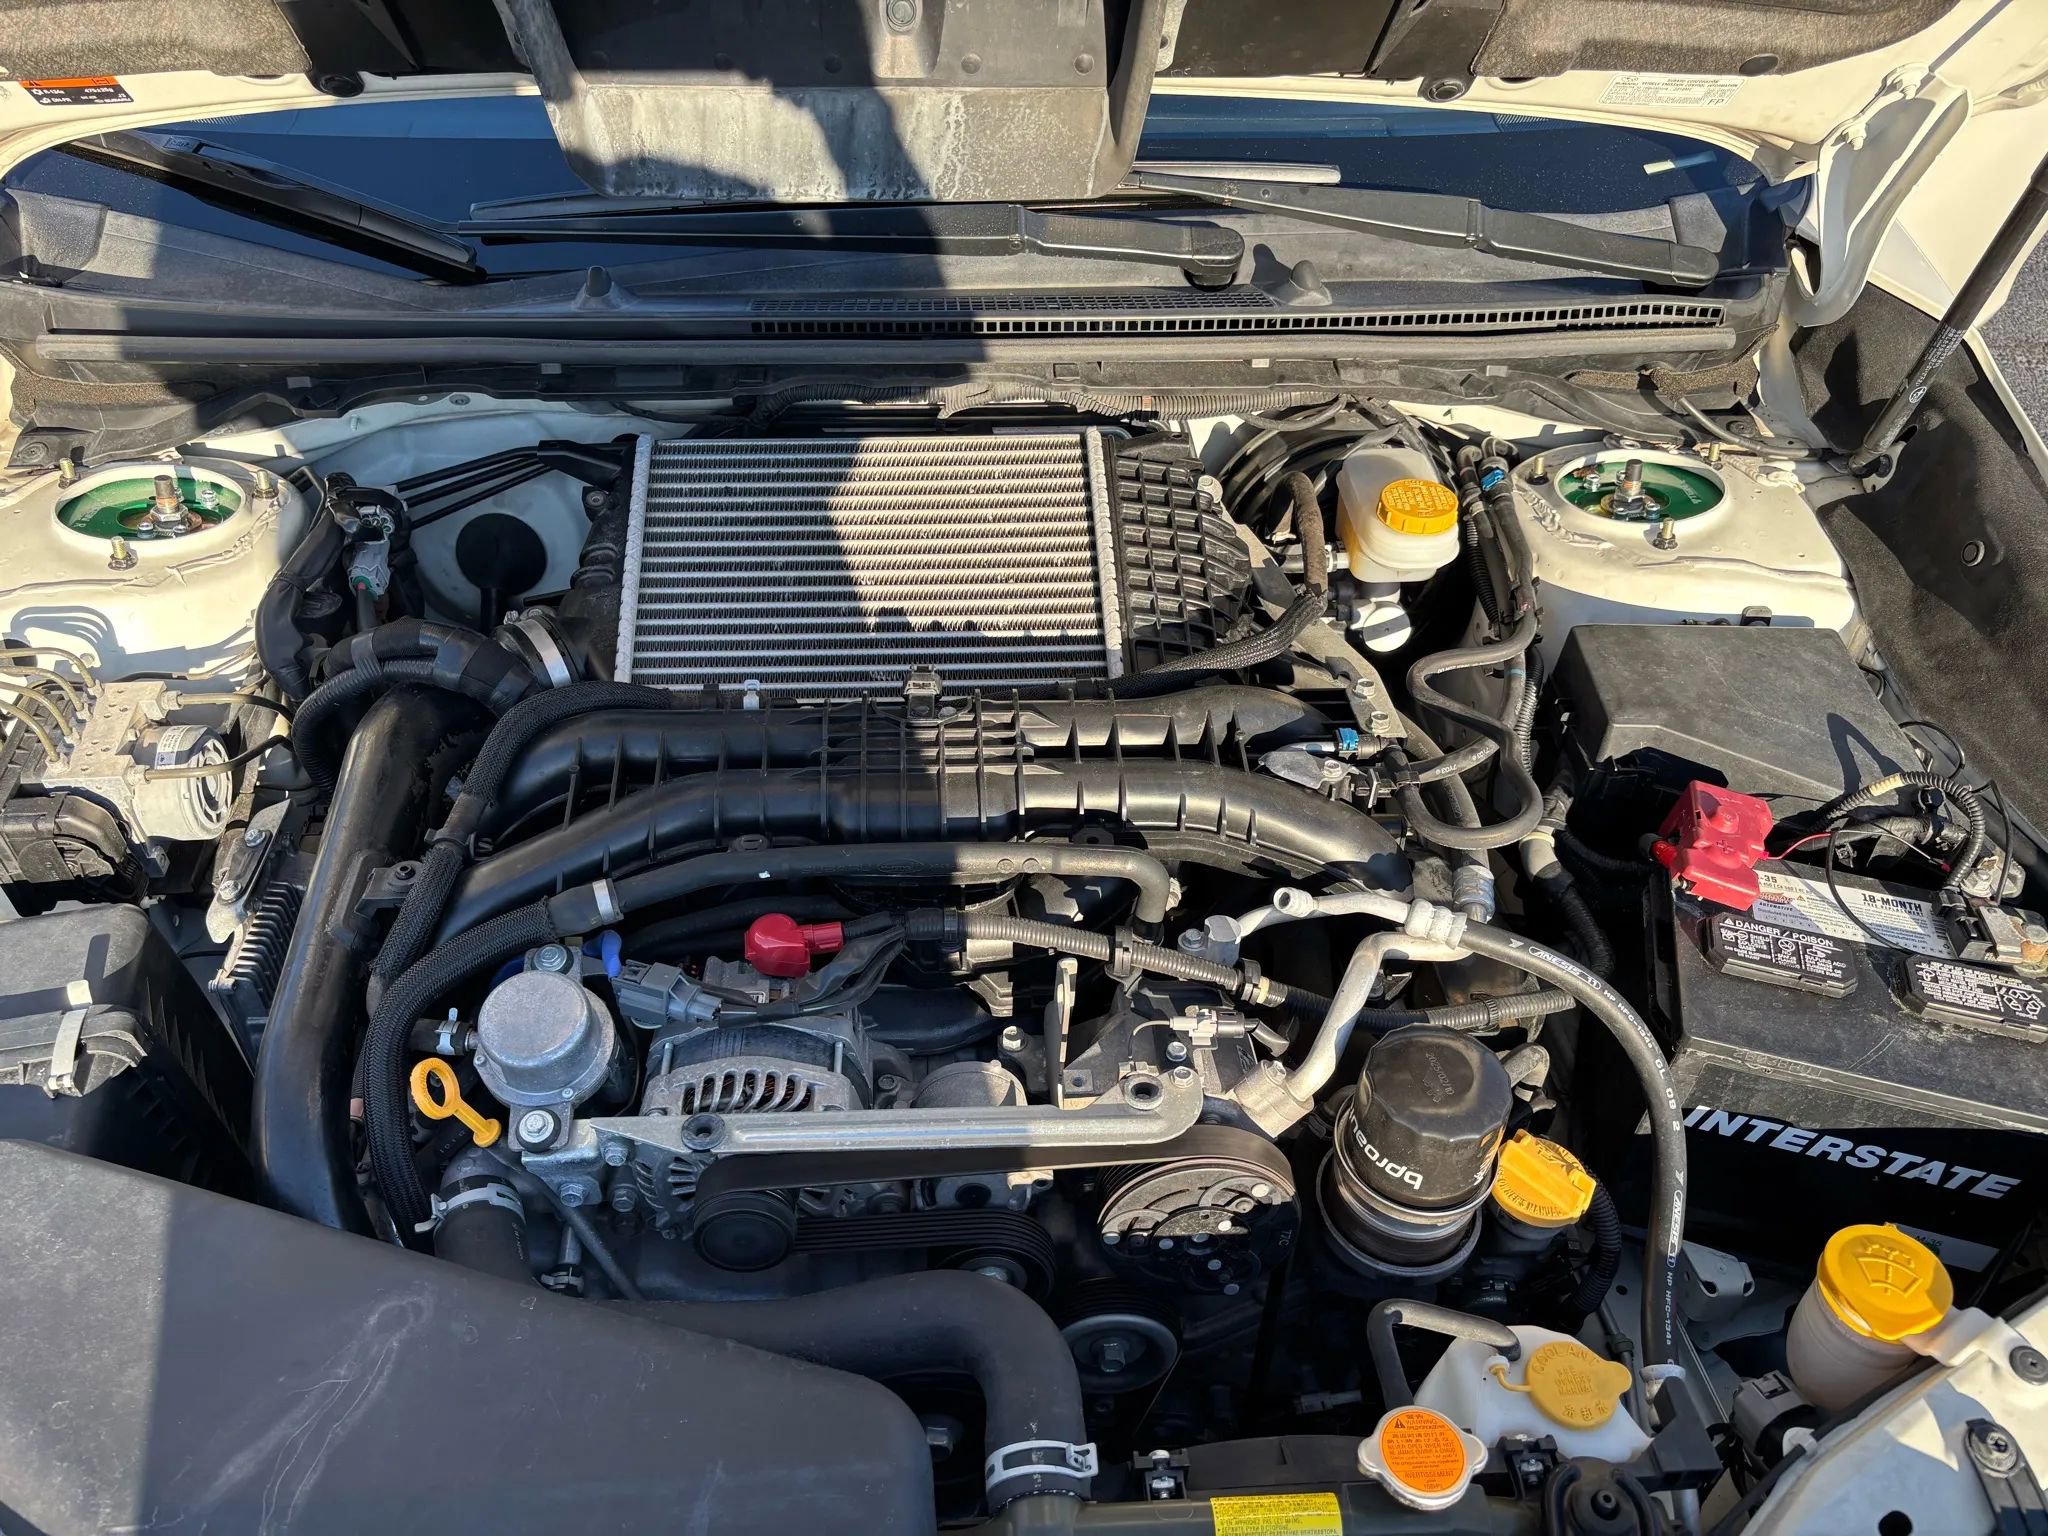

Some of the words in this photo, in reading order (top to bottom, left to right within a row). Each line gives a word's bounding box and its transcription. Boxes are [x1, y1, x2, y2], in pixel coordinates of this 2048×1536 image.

[1861, 893, 1922, 912] 18-MONTH
[1735, 920, 1780, 936] DANGER
[1792, 932, 1833, 947] POISON
[1603, 990, 1616, 1002] HP
[1655, 1059, 1666, 1079] GL
[1350, 1107, 1424, 1191] bproau
[1683, 1105, 2022, 1199] INTERSTATE
[1531, 1343, 1600, 1375] COOLANT
